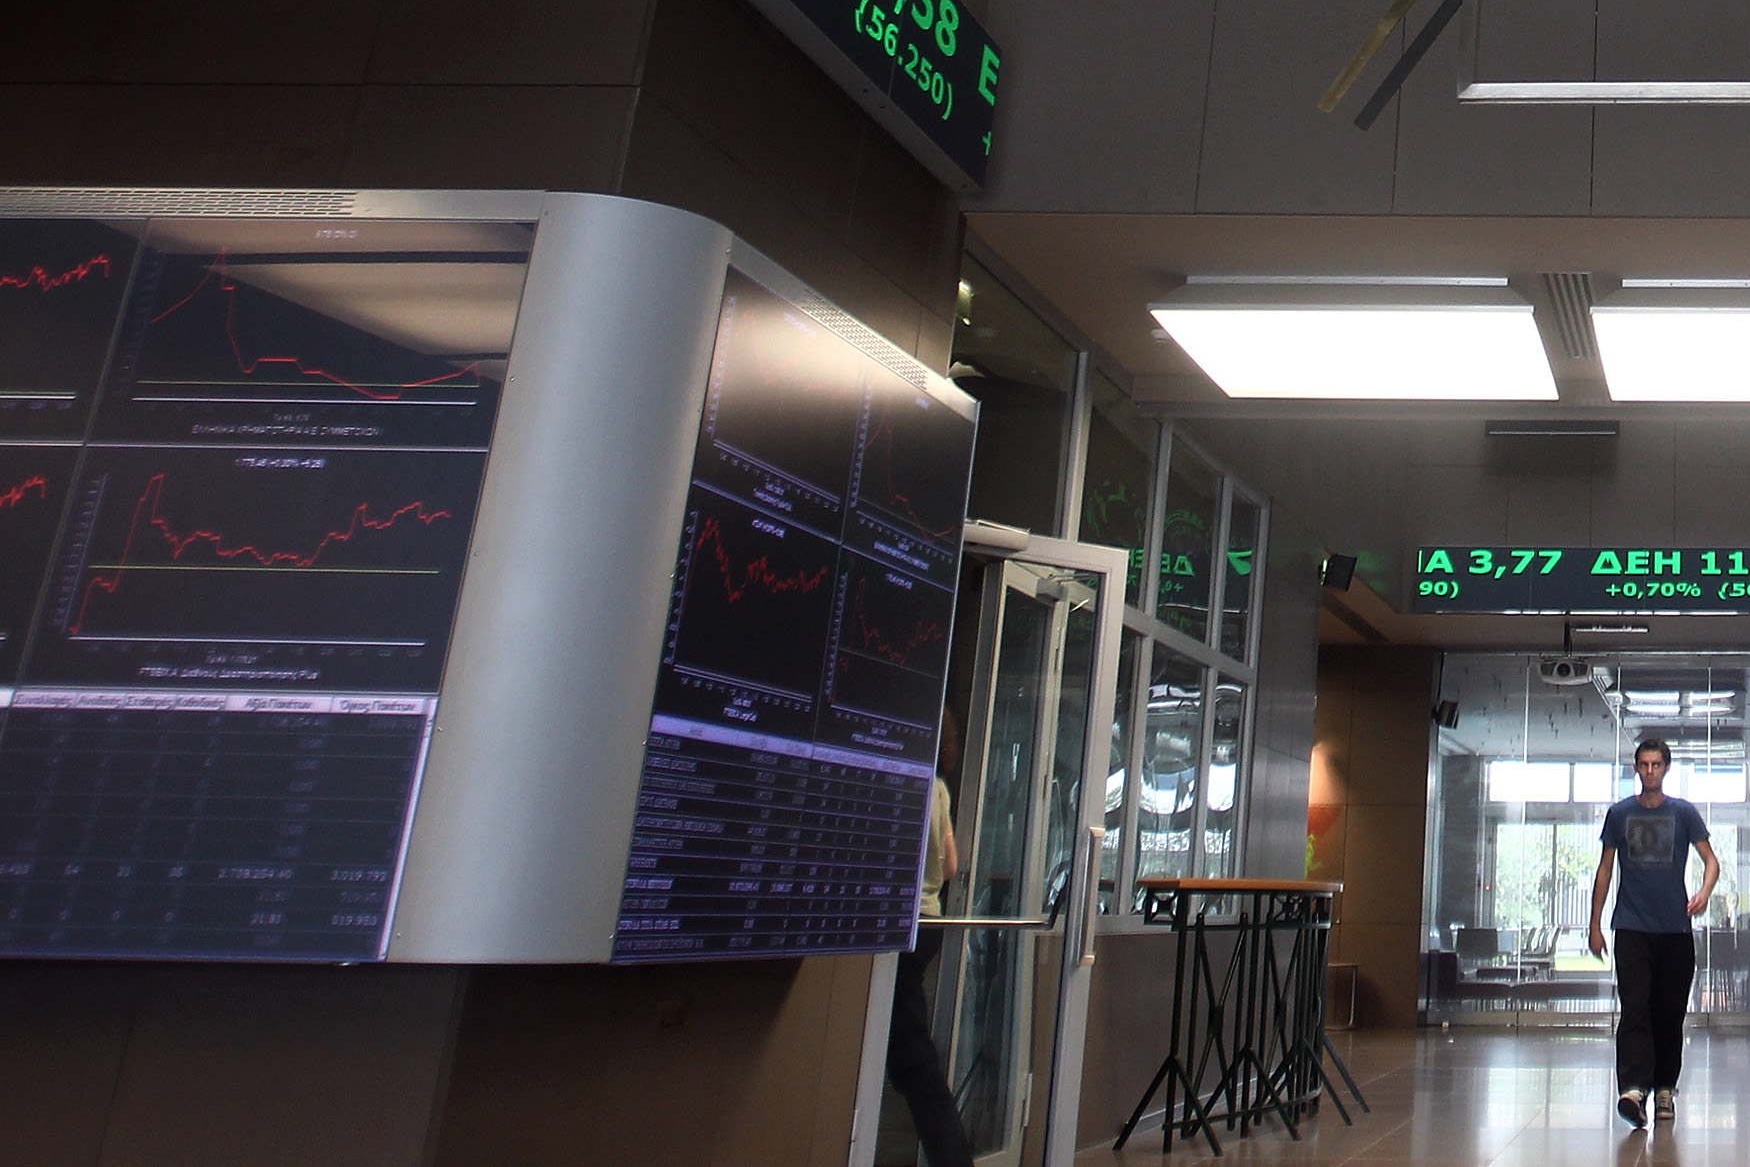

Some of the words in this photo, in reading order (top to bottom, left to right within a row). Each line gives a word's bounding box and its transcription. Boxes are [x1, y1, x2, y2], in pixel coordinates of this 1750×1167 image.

[1418, 550, 1454, 574] Α
[1468, 550, 1563, 580] 3,77
[1590, 550, 1682, 575] ΔΕΗ
[1605, 581, 1702, 599] +0,70%
